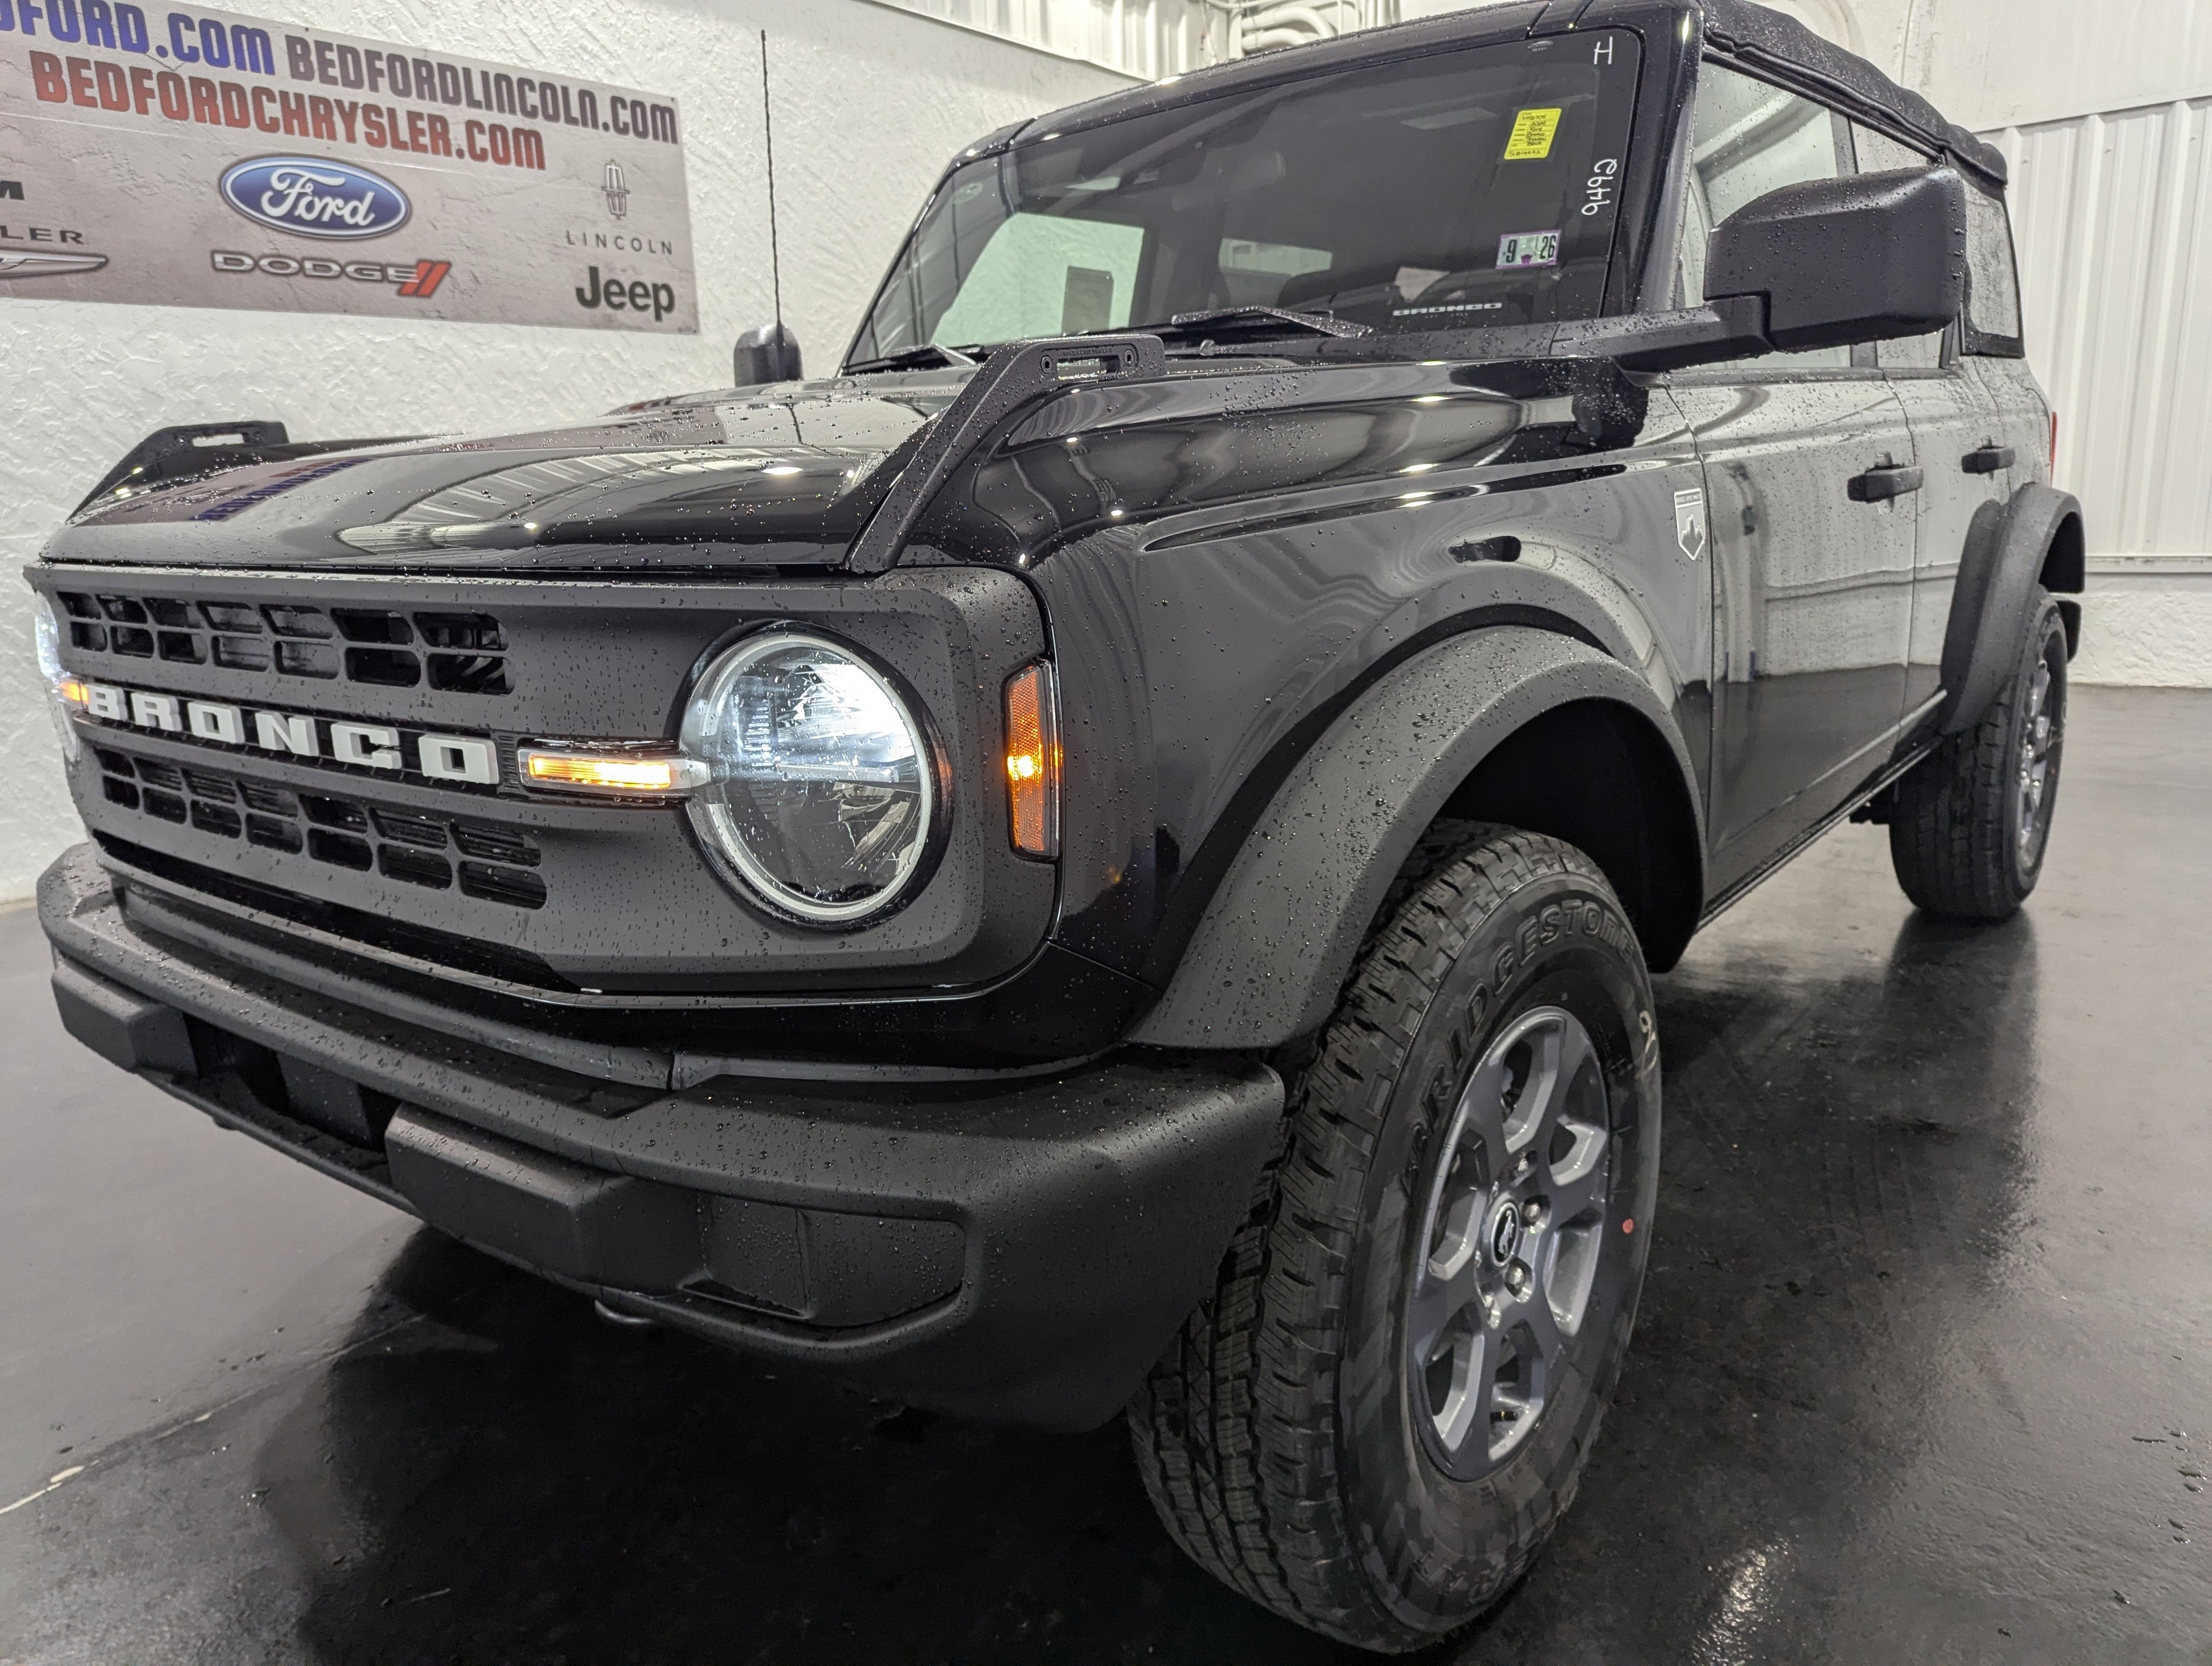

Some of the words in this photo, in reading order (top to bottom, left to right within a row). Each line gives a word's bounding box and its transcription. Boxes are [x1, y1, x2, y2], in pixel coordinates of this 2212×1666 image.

[30, 50, 545, 170] BEDFORDCHRYSLER.COM
[261, 168, 375, 226] Ford
[1581, 159, 1617, 215] 9492
[211, 251, 420, 283] DODGE
[566, 231, 672, 255] LINCOLN
[1506, 239, 1517, 263] 9
[575, 266, 675, 322] Jeep
[1393, 303, 1502, 316] BRONCO
[87, 683, 499, 784] BRONCO
